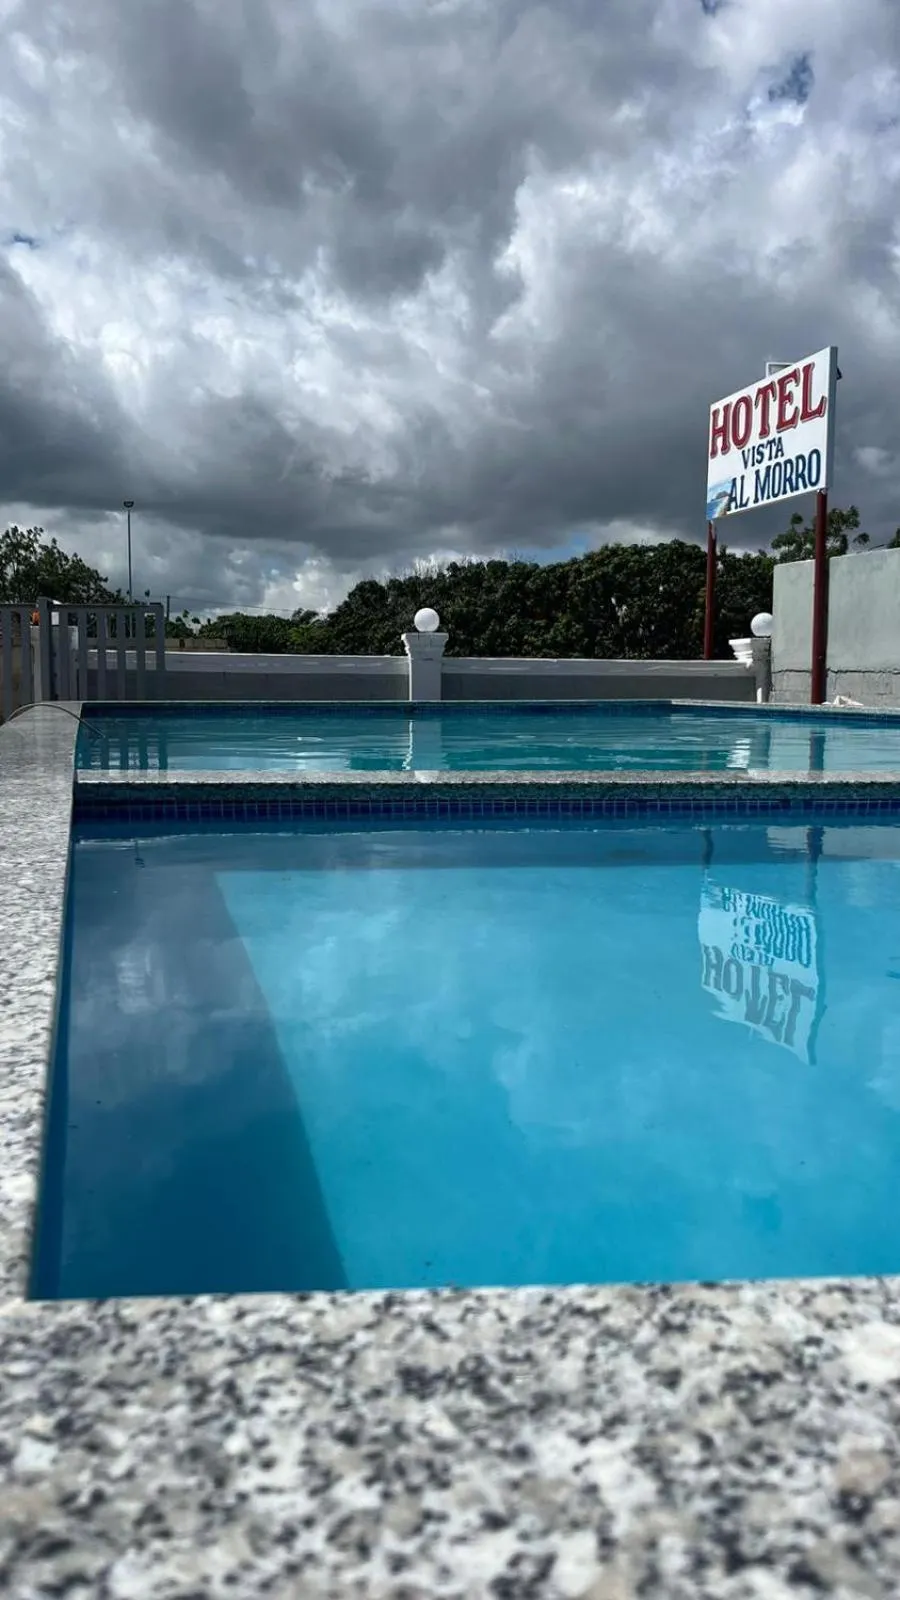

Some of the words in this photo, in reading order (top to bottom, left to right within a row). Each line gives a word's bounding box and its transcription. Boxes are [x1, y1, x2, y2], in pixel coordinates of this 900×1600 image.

[710, 361, 827, 459] HOTEL
[727, 474, 750, 512] AL
[753, 448, 821, 504] MORRO
[742, 436, 785, 470] VISTA
